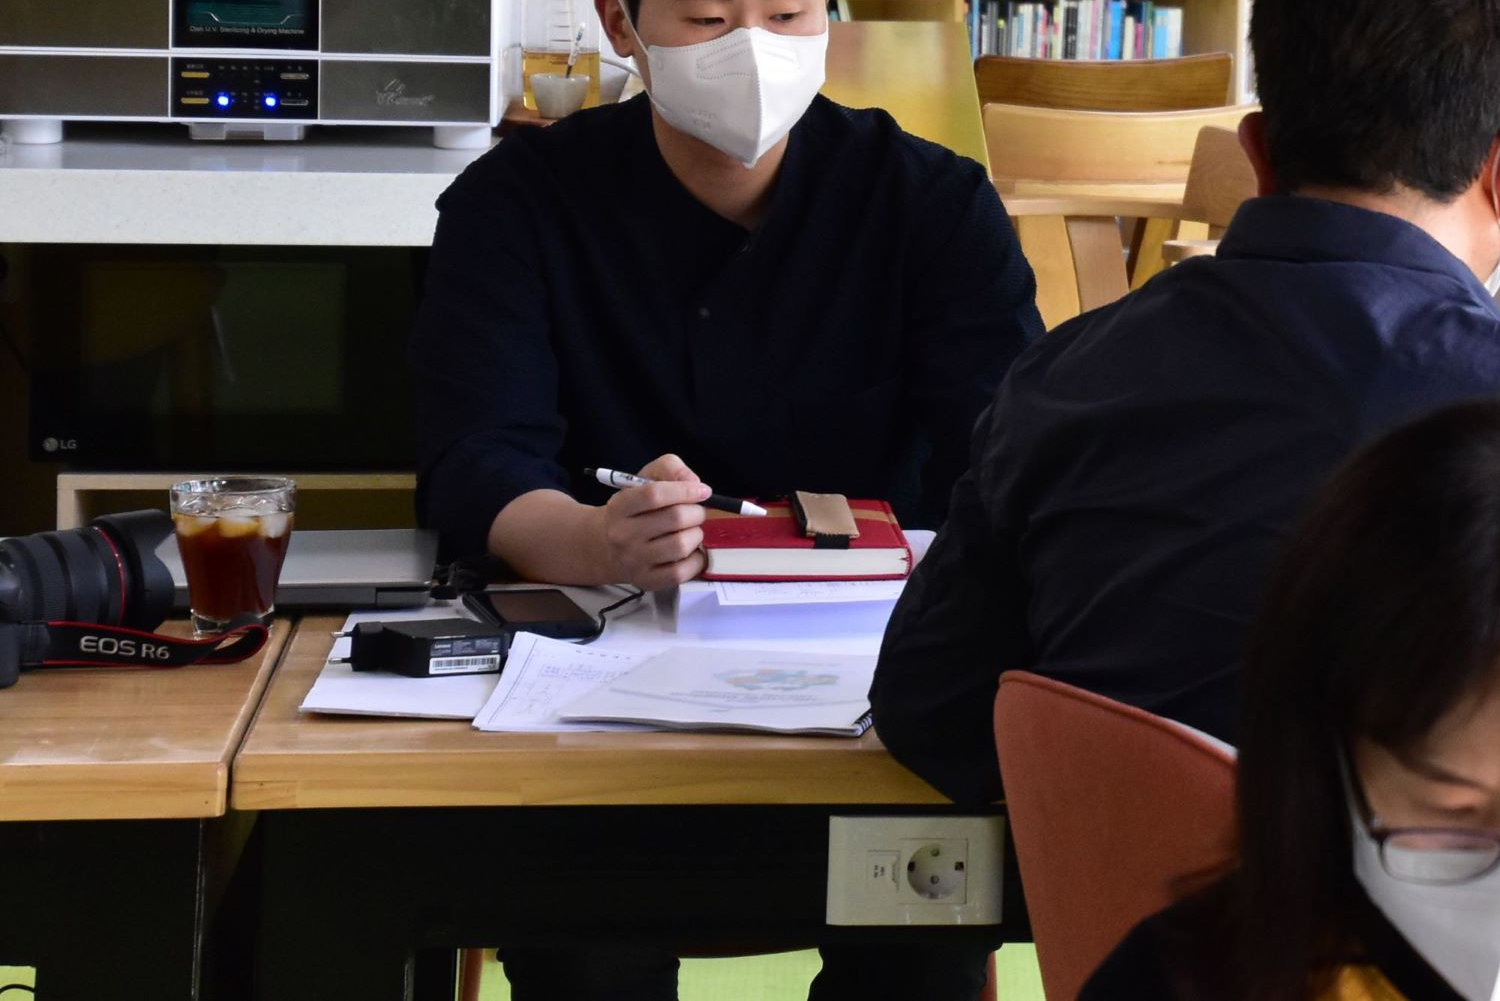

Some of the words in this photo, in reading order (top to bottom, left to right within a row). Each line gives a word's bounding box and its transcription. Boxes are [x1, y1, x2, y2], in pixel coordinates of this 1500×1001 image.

[60, 439, 77, 449] LG
[80, 635, 136, 656] EOS
[141, 643, 170, 660] R6
